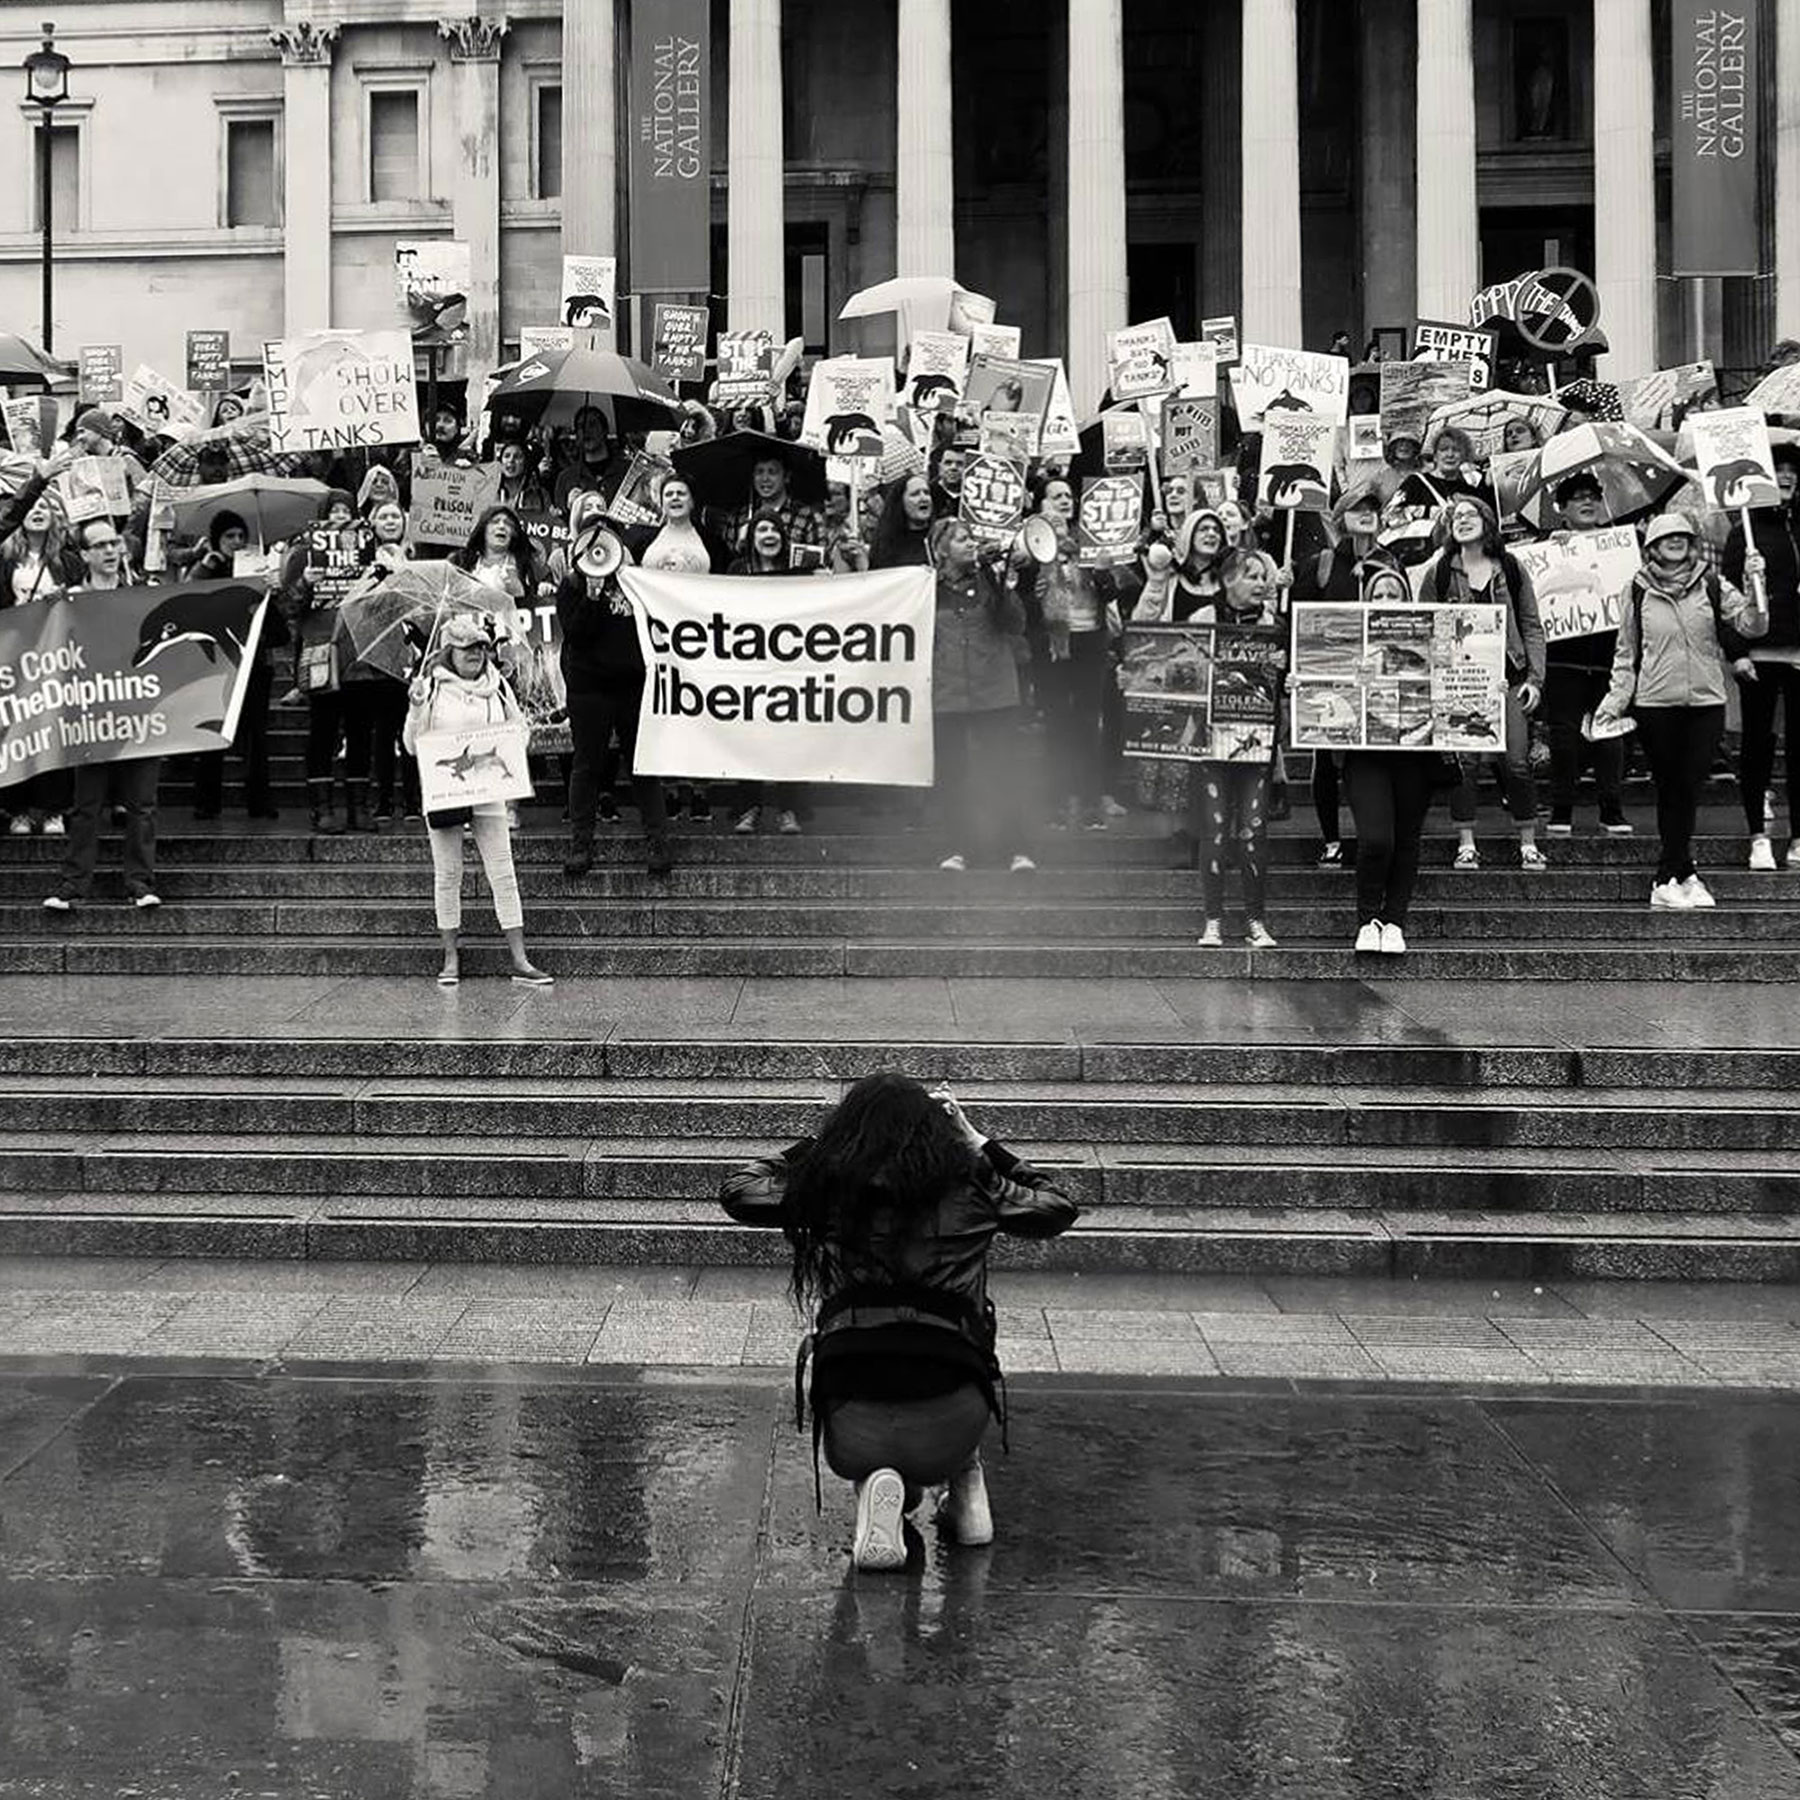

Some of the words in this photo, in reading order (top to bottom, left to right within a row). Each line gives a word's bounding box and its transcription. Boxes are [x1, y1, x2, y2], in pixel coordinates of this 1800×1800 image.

[1696, 9, 1717, 157] NATIONAL
[1721, 11, 1745, 158] GALLERY
[654, 36, 675, 178] NATIONAL
[677, 37, 700, 179] GALLERY
[662, 332, 699, 343] EMPTY
[1419, 328, 1488, 351] EMPTY
[730, 357, 760, 373] THE
[1435, 348, 1473, 361] THE
[337, 363, 411, 386] SHOW
[1243, 364, 1275, 387] NO
[1286, 369, 1345, 395] TANKS!
[264, 342, 291, 452] EMPTY
[339, 392, 408, 415] OVER
[303, 421, 384, 449] TANKS
[965, 476, 1022, 507] STOP
[434, 497, 474, 514] PRISON
[1083, 497, 1141, 524] STOP
[312, 529, 374, 551] STOP
[527, 523, 549, 536] NO
[1585, 532, 1632, 550] Tanks
[325, 550, 360, 568] THE
[648, 612, 916, 662] cetacean
[21, 639, 87, 682] Cook
[652, 663, 912, 724] liberation
[0, 725, 52, 774] your
[58, 710, 168, 747] holidays
